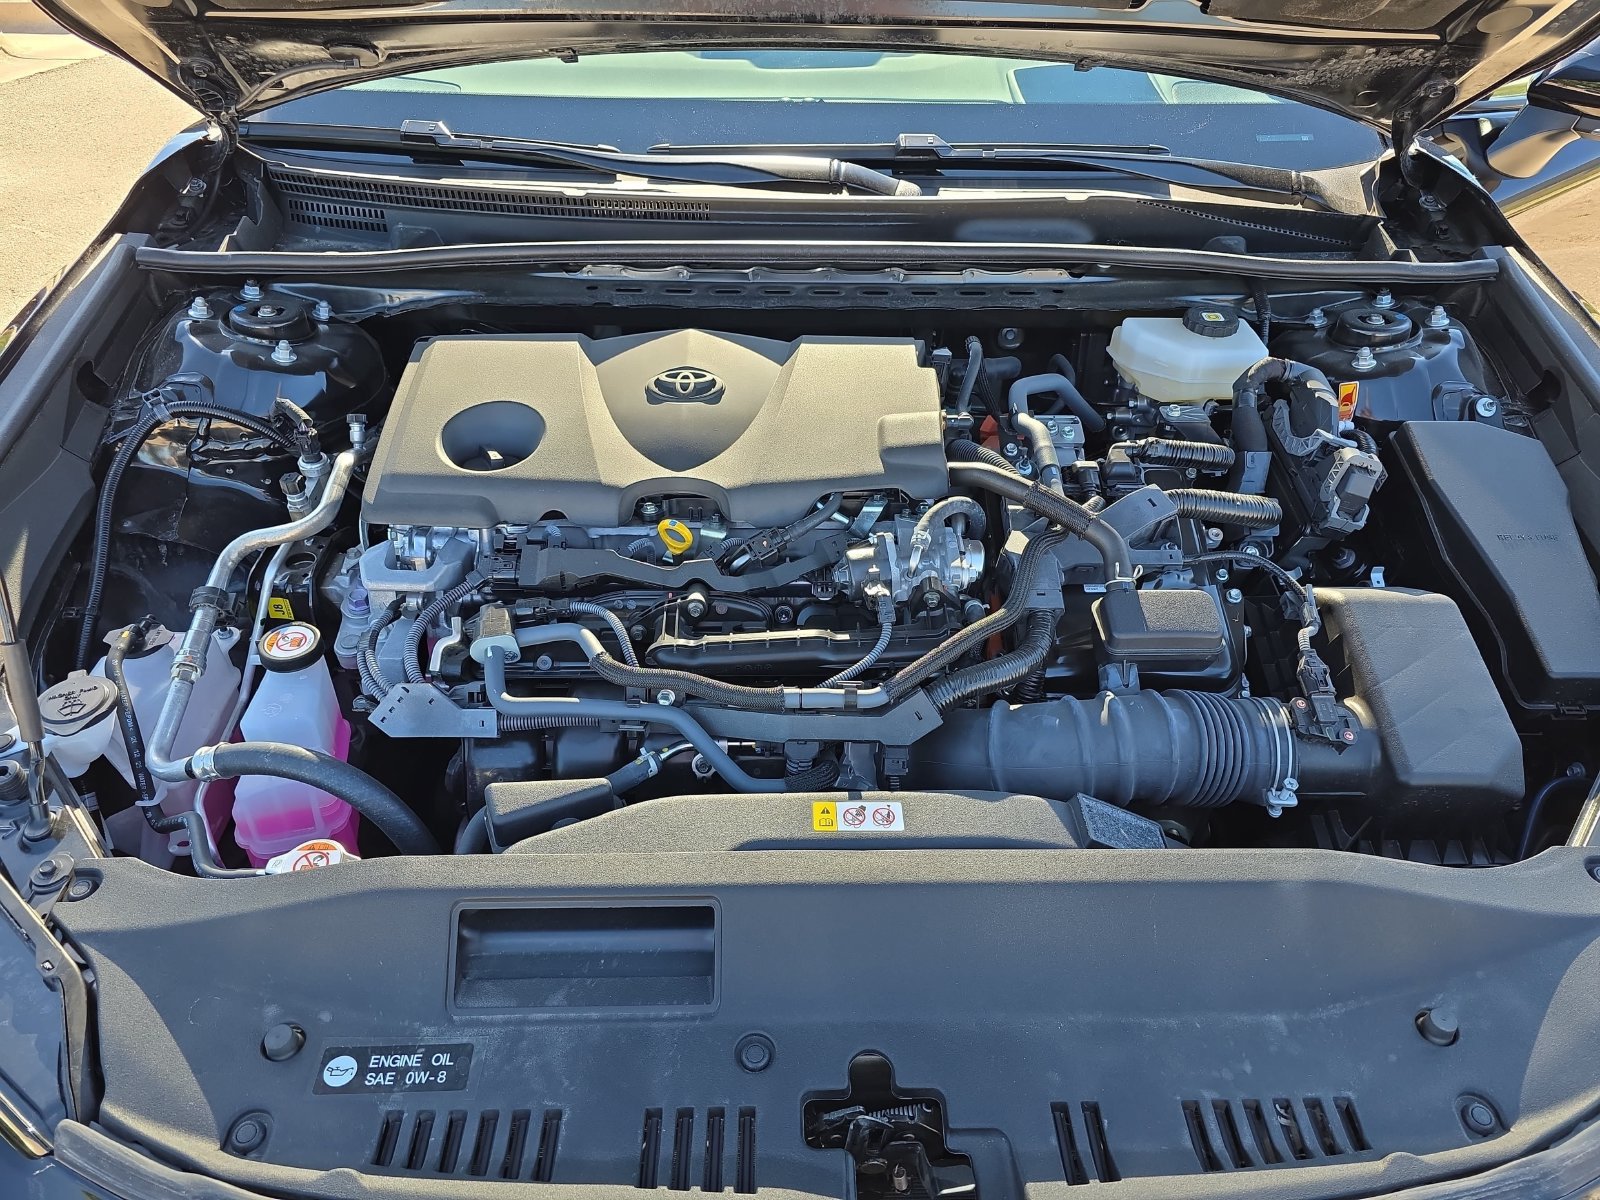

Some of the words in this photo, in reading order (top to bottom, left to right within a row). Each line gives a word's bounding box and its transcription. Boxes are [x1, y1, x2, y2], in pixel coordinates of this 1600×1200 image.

[120, 689, 129, 707] WATER
[138, 772, 147, 789] WATER
[369, 1054, 423, 1068] ENGINE
[431, 1053, 454, 1066] OIL
[364, 1072, 395, 1086] SAE
[405, 1070, 447, 1085] 0W-8
